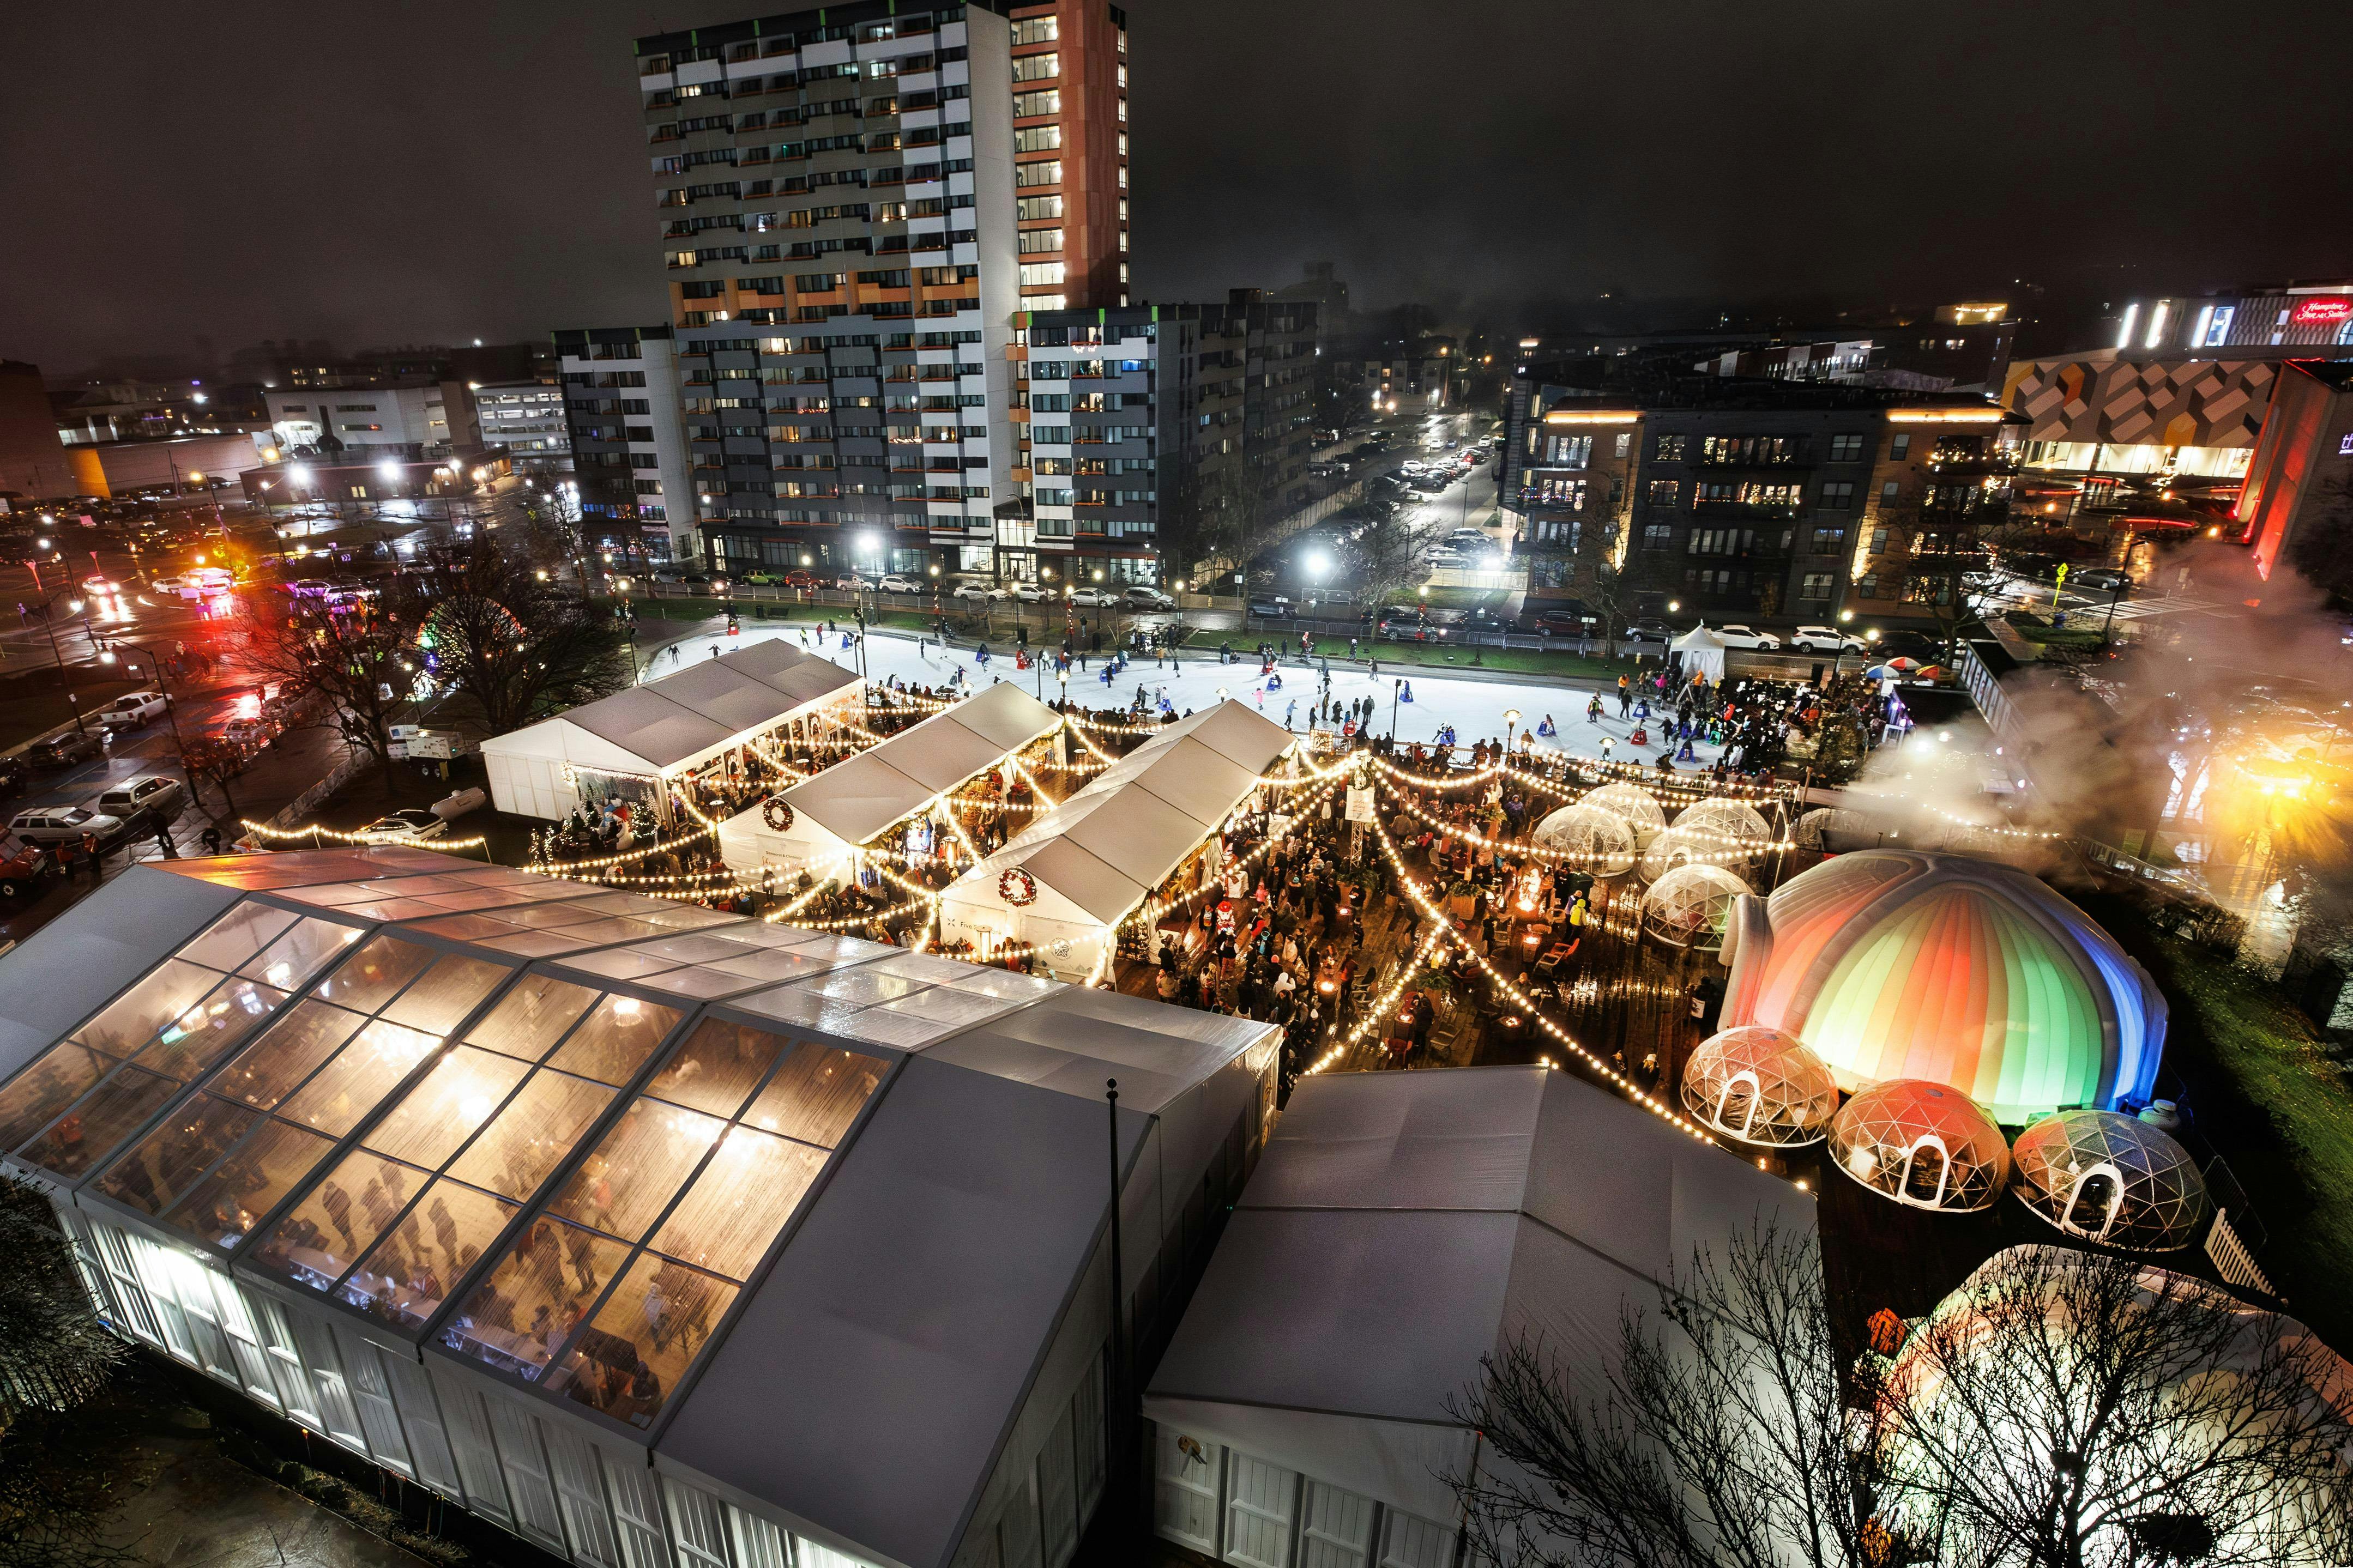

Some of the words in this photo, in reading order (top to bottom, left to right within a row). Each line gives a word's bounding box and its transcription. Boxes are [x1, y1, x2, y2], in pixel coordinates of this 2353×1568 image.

[2302, 302, 2347, 312] Hampton
[2297, 311, 2318, 319] Inn
[1314, 736, 1328, 748] Bar
